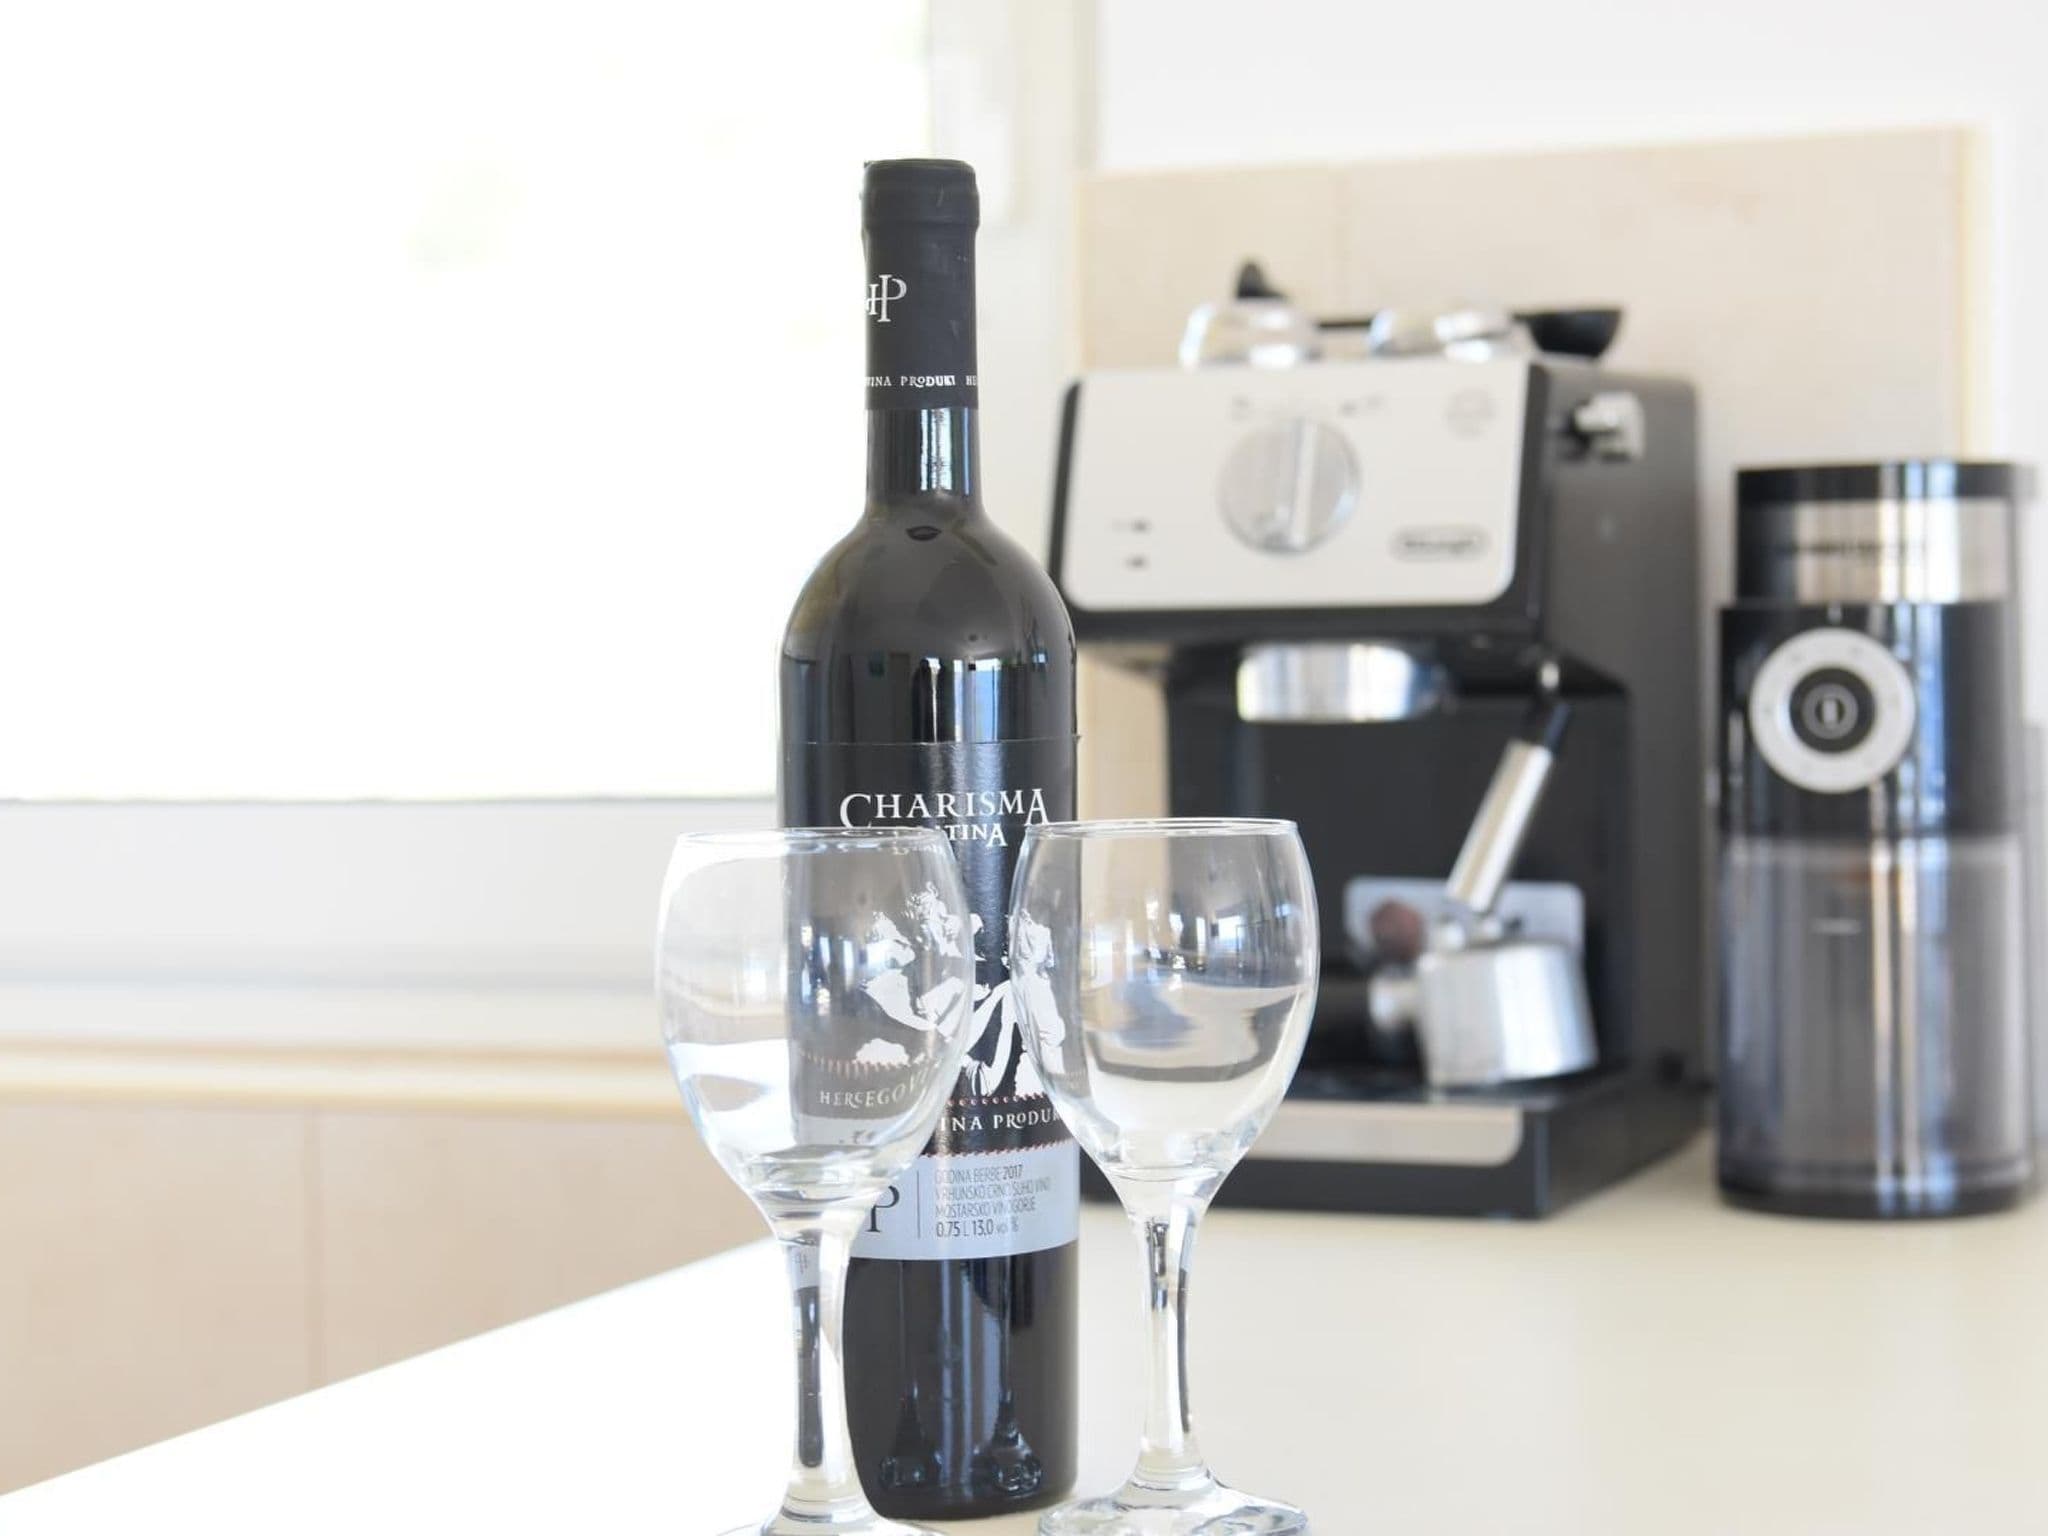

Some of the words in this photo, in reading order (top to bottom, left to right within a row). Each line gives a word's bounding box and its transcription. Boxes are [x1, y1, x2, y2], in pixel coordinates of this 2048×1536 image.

[839, 788, 1050, 830] CHARISMA
[933, 822, 1009, 848] TINA
[1003, 1164, 1023, 1180] 2017
[972, 1218, 994, 1237] 13.0
